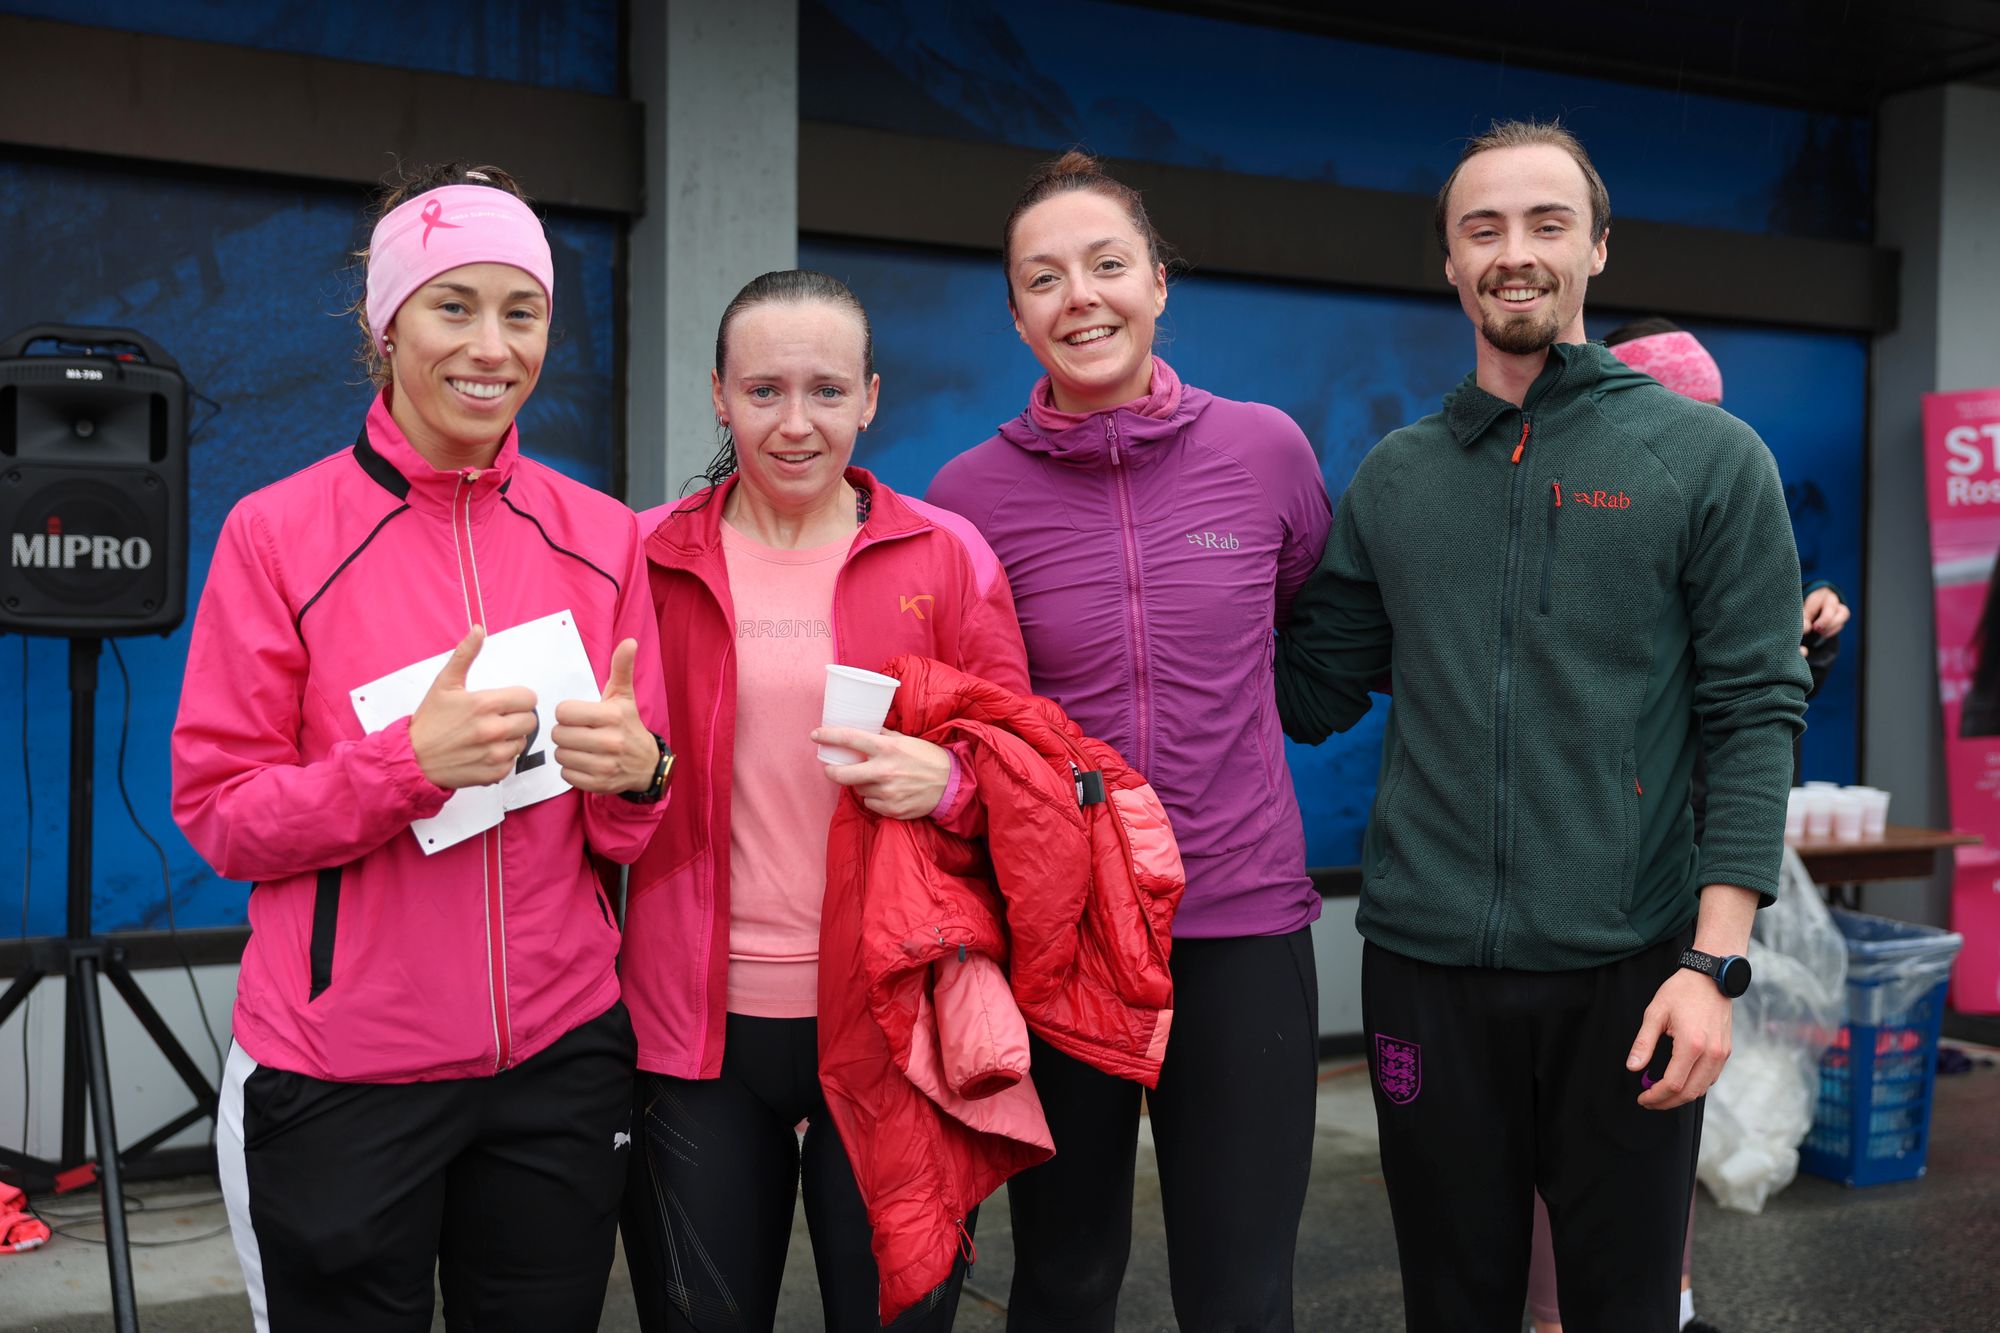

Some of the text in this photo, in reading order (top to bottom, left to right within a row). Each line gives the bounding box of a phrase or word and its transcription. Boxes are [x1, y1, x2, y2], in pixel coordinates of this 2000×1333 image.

[1592, 489, 1631, 509] Rab
[1204, 531, 1240, 550] Rab
[735, 618, 831, 639] RRØNA
